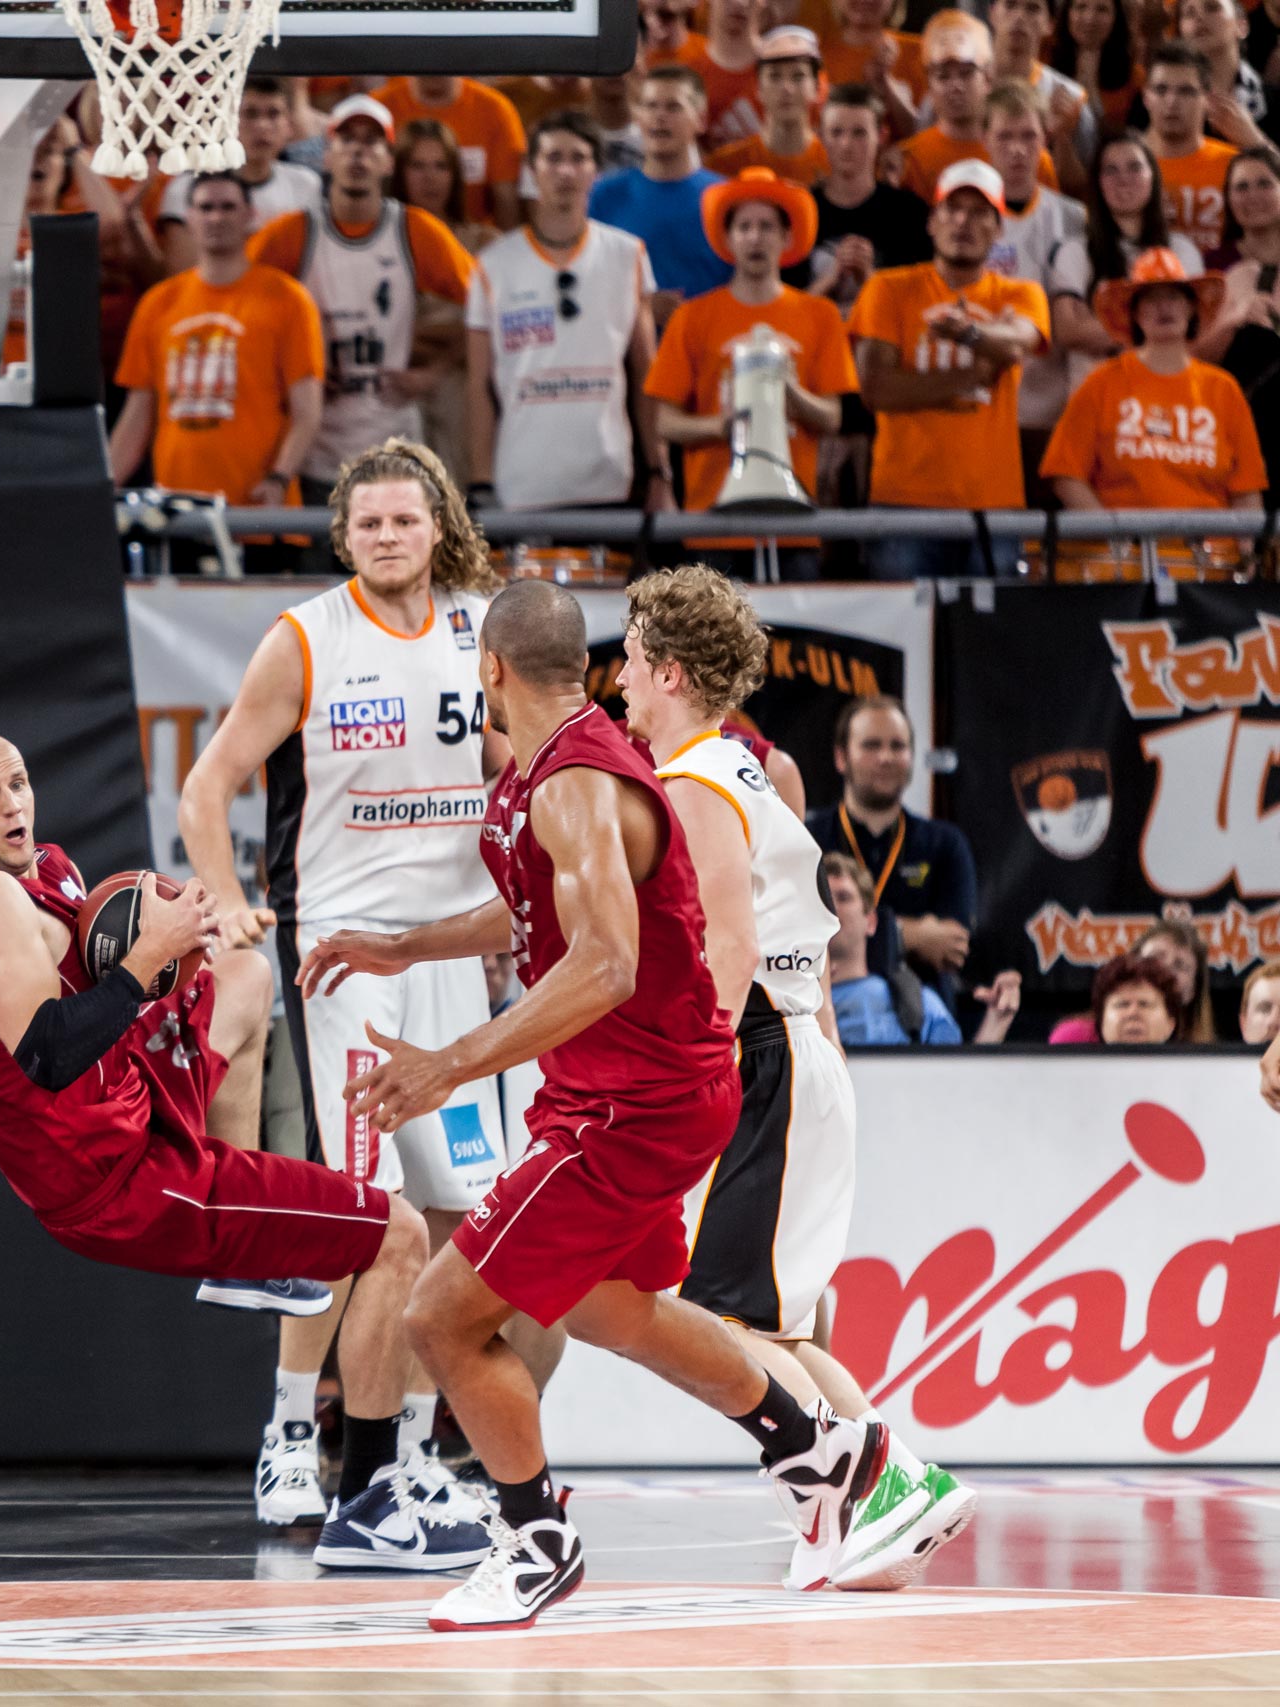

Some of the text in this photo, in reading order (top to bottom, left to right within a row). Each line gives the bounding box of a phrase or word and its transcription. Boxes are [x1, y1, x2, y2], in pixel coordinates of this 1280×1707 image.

[333, 698, 404, 726] LIQUI
[436, 691, 485, 745] 54
[335, 722, 406, 750] MOLY
[352, 796, 484, 824] ratiopharm
[452, 1138, 486, 1161] SWU
